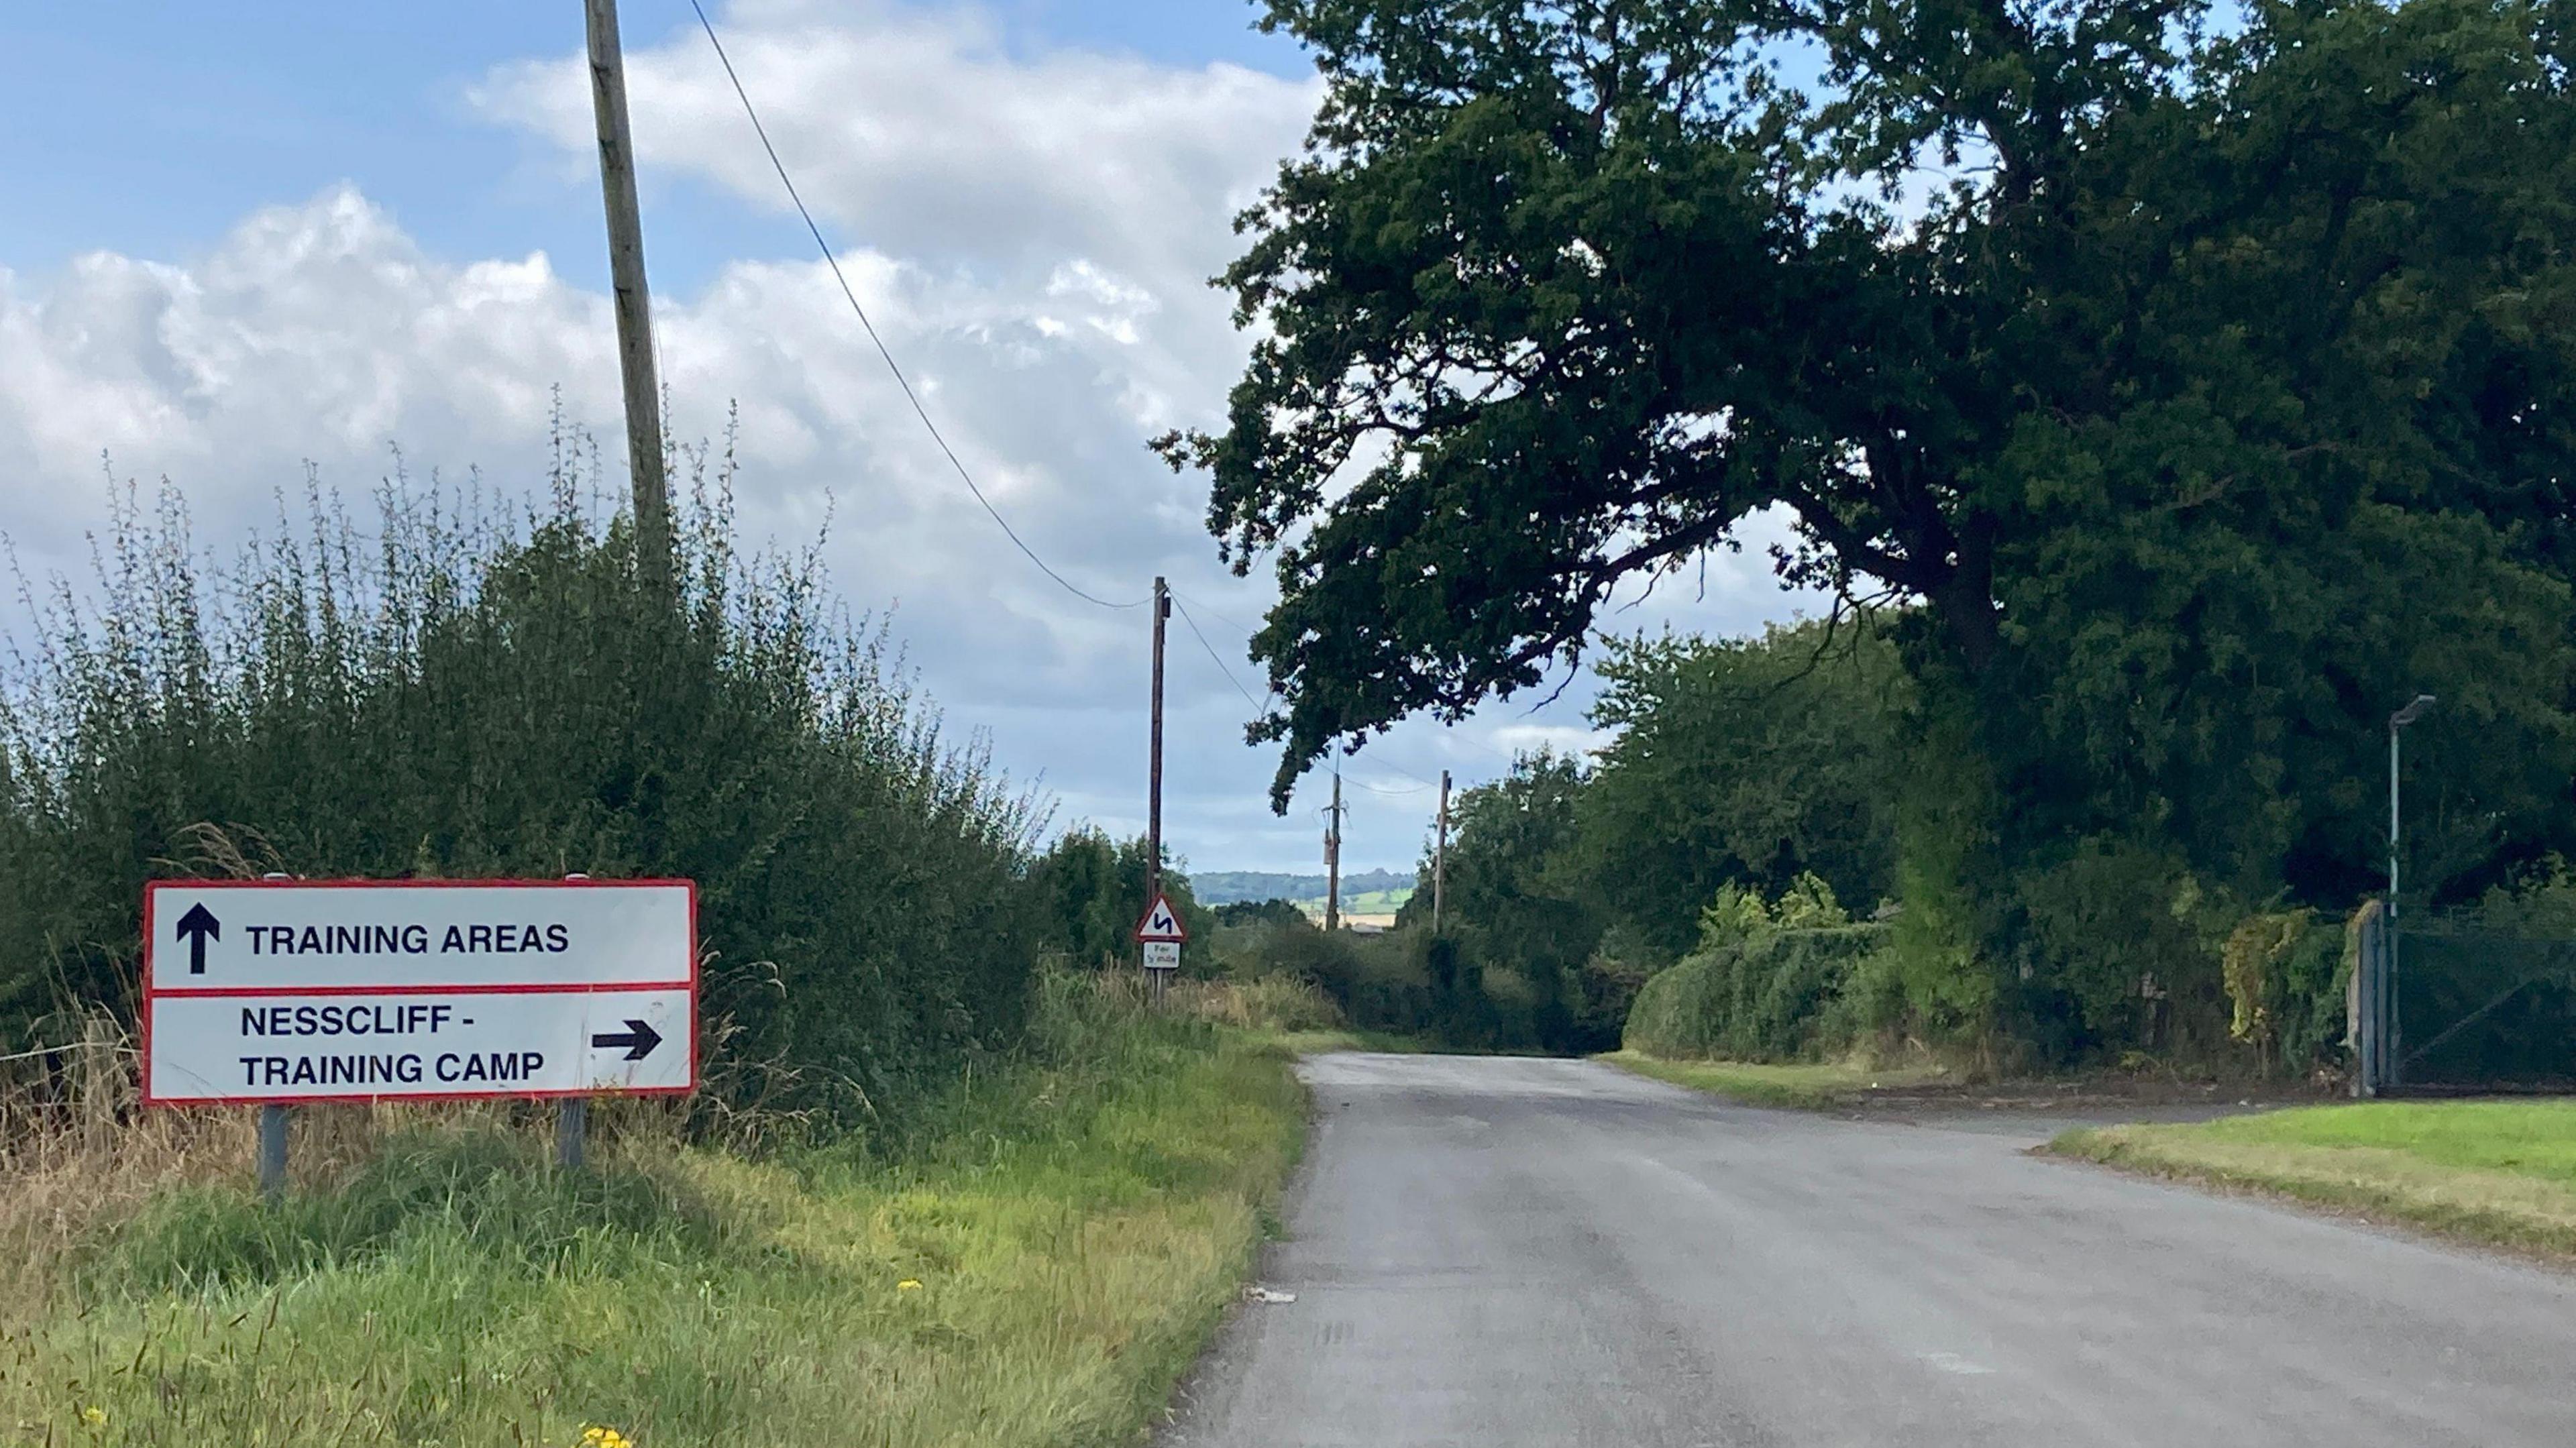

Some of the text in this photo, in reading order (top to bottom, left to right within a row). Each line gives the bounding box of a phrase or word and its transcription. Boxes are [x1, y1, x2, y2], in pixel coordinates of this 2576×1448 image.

[246, 924, 569, 955] TRAINING AREAS
[241, 1005, 451, 1036] NESSCLIFF
[239, 1052, 544, 1085] TRAINING CAMP
